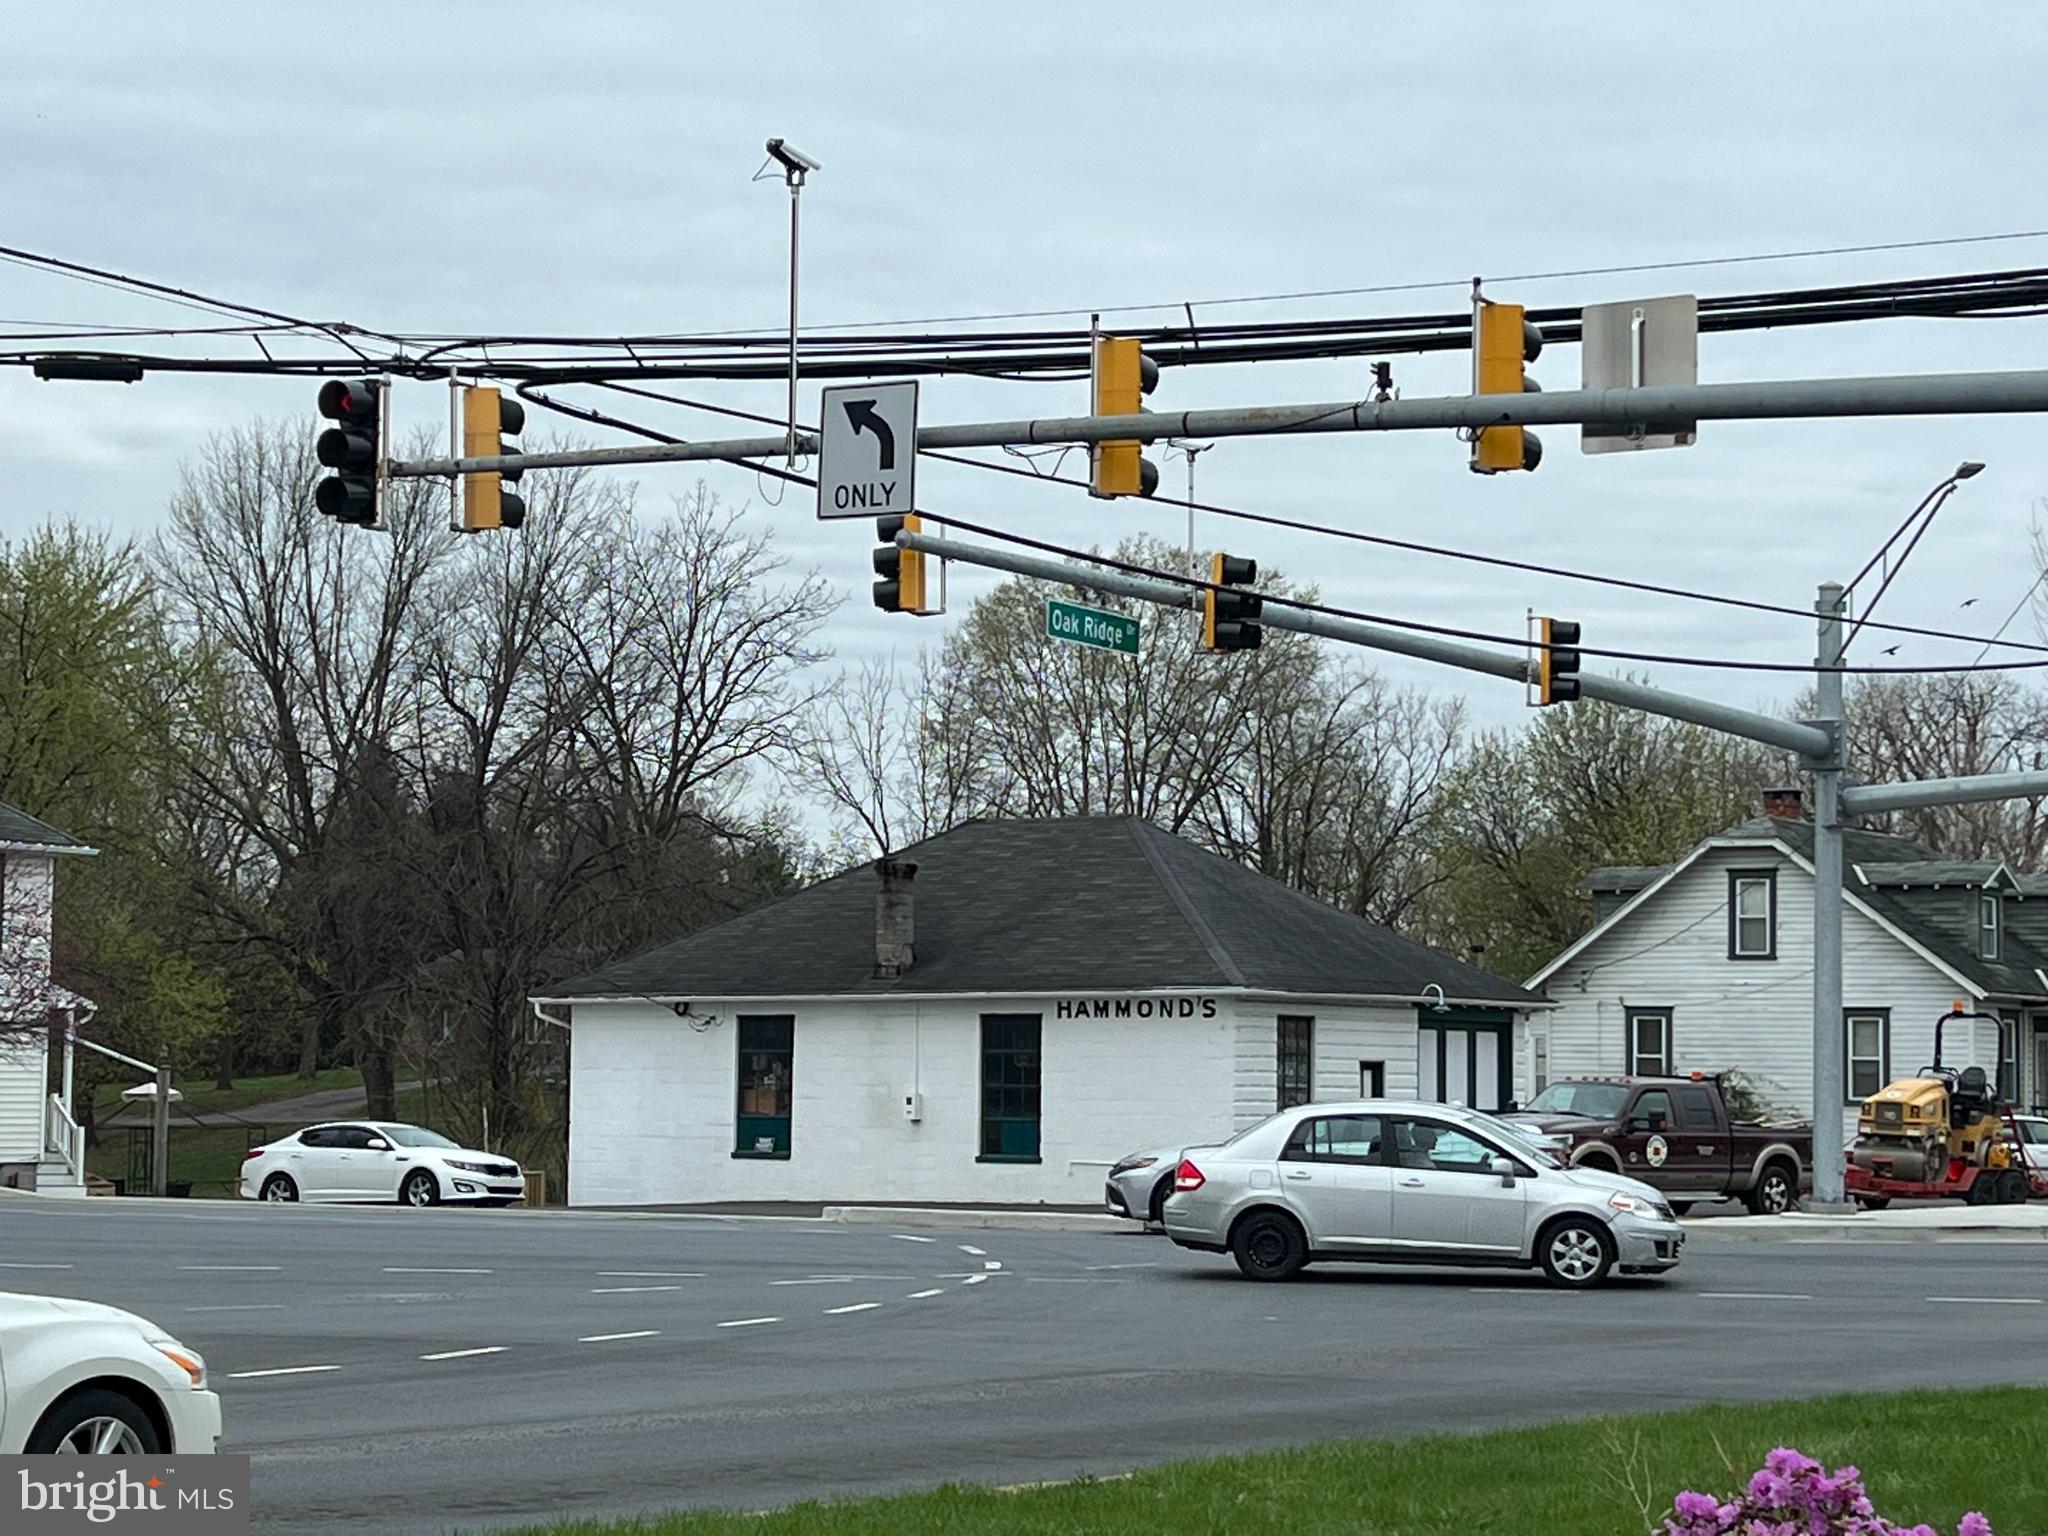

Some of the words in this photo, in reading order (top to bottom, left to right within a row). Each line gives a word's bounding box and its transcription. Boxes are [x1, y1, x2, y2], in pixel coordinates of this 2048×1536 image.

[835, 481, 896, 509] ONLY
[1052, 609, 1079, 635] Oak
[1084, 616, 1123, 648] Ridge
[1056, 997, 1217, 1019] HAMMOND'S
